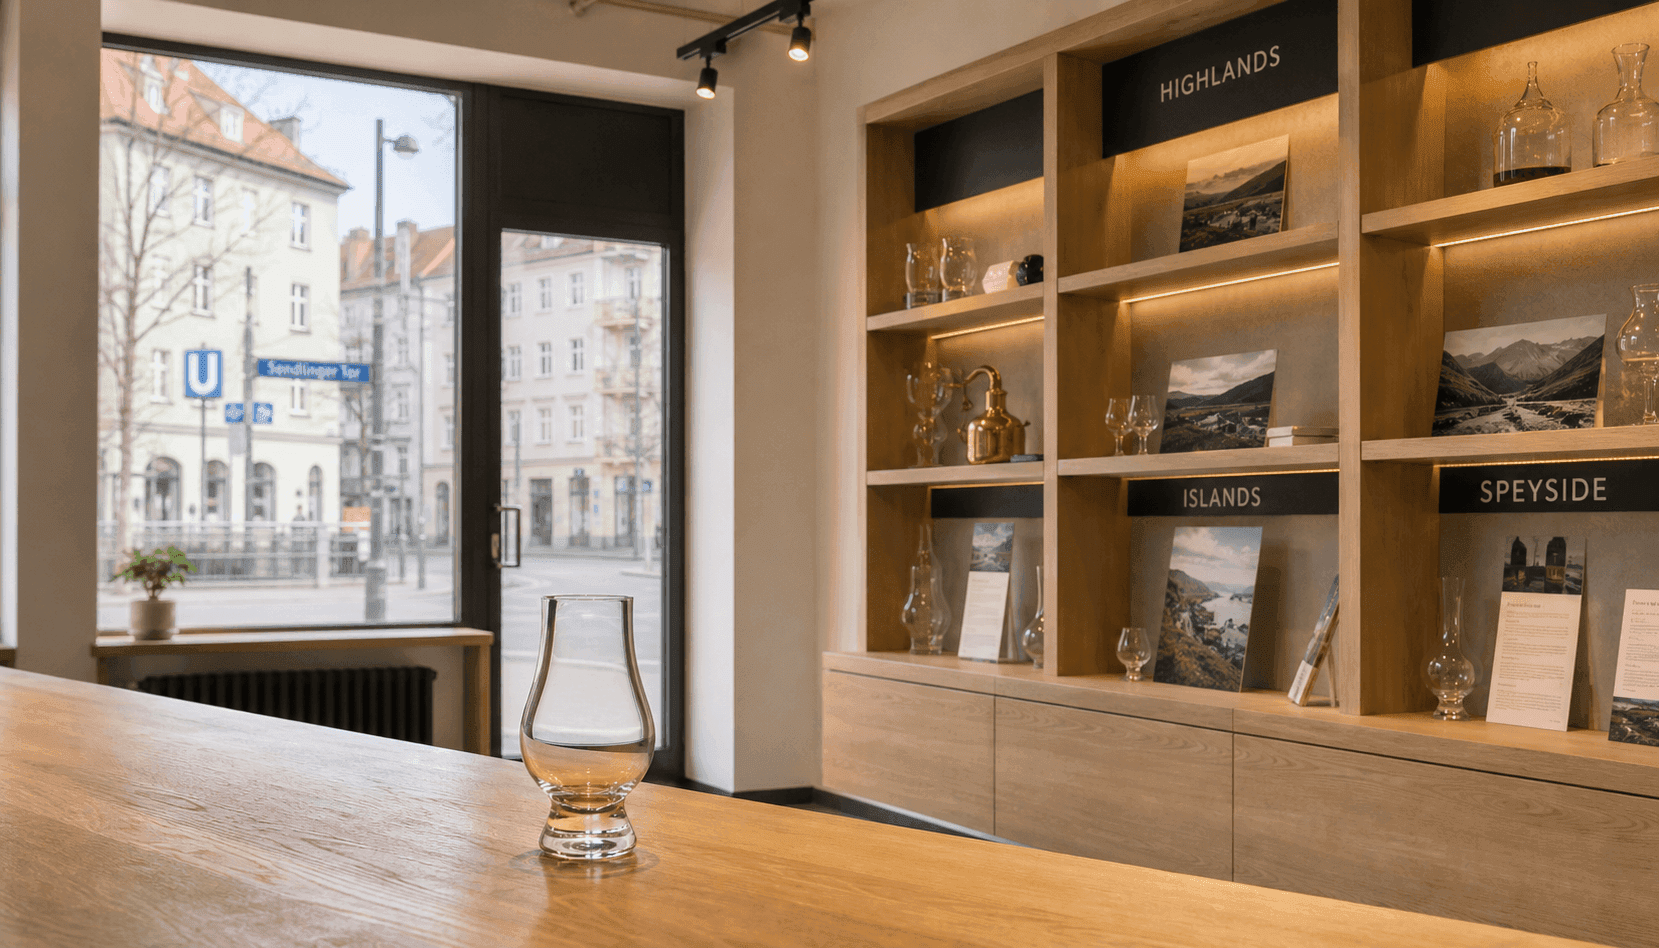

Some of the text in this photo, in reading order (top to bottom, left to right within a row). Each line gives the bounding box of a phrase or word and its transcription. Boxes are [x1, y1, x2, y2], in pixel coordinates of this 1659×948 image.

[1160, 45, 1280, 103] HIGHLANDS
[189, 352, 219, 394] U
[1183, 486, 1261, 508] ISLANDS
[1480, 477, 1608, 504] SPEYSIDE
